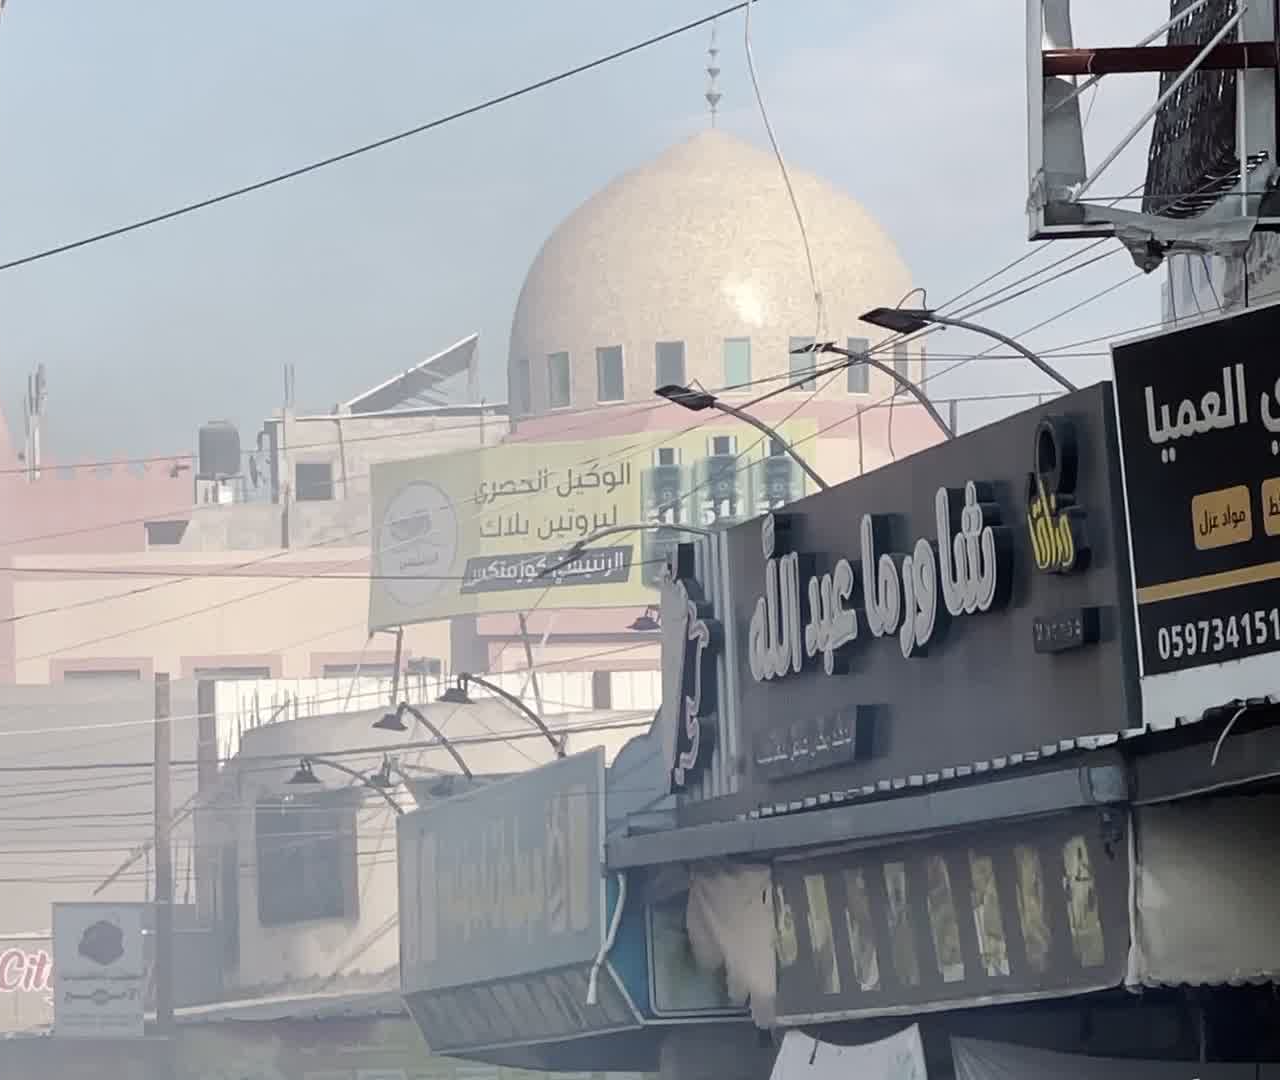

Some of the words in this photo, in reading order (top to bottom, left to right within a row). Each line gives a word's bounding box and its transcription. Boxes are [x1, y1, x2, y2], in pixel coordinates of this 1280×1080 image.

[1144, 363, 1248, 463] العميا
[557, 462, 631, 498] الوكيل
[1222, 503, 1246, 529] مواد
[749, 512, 802, 681] الله
[860, 480, 997, 659] شاورما
[1158, 607, 1280, 660] 059734151
